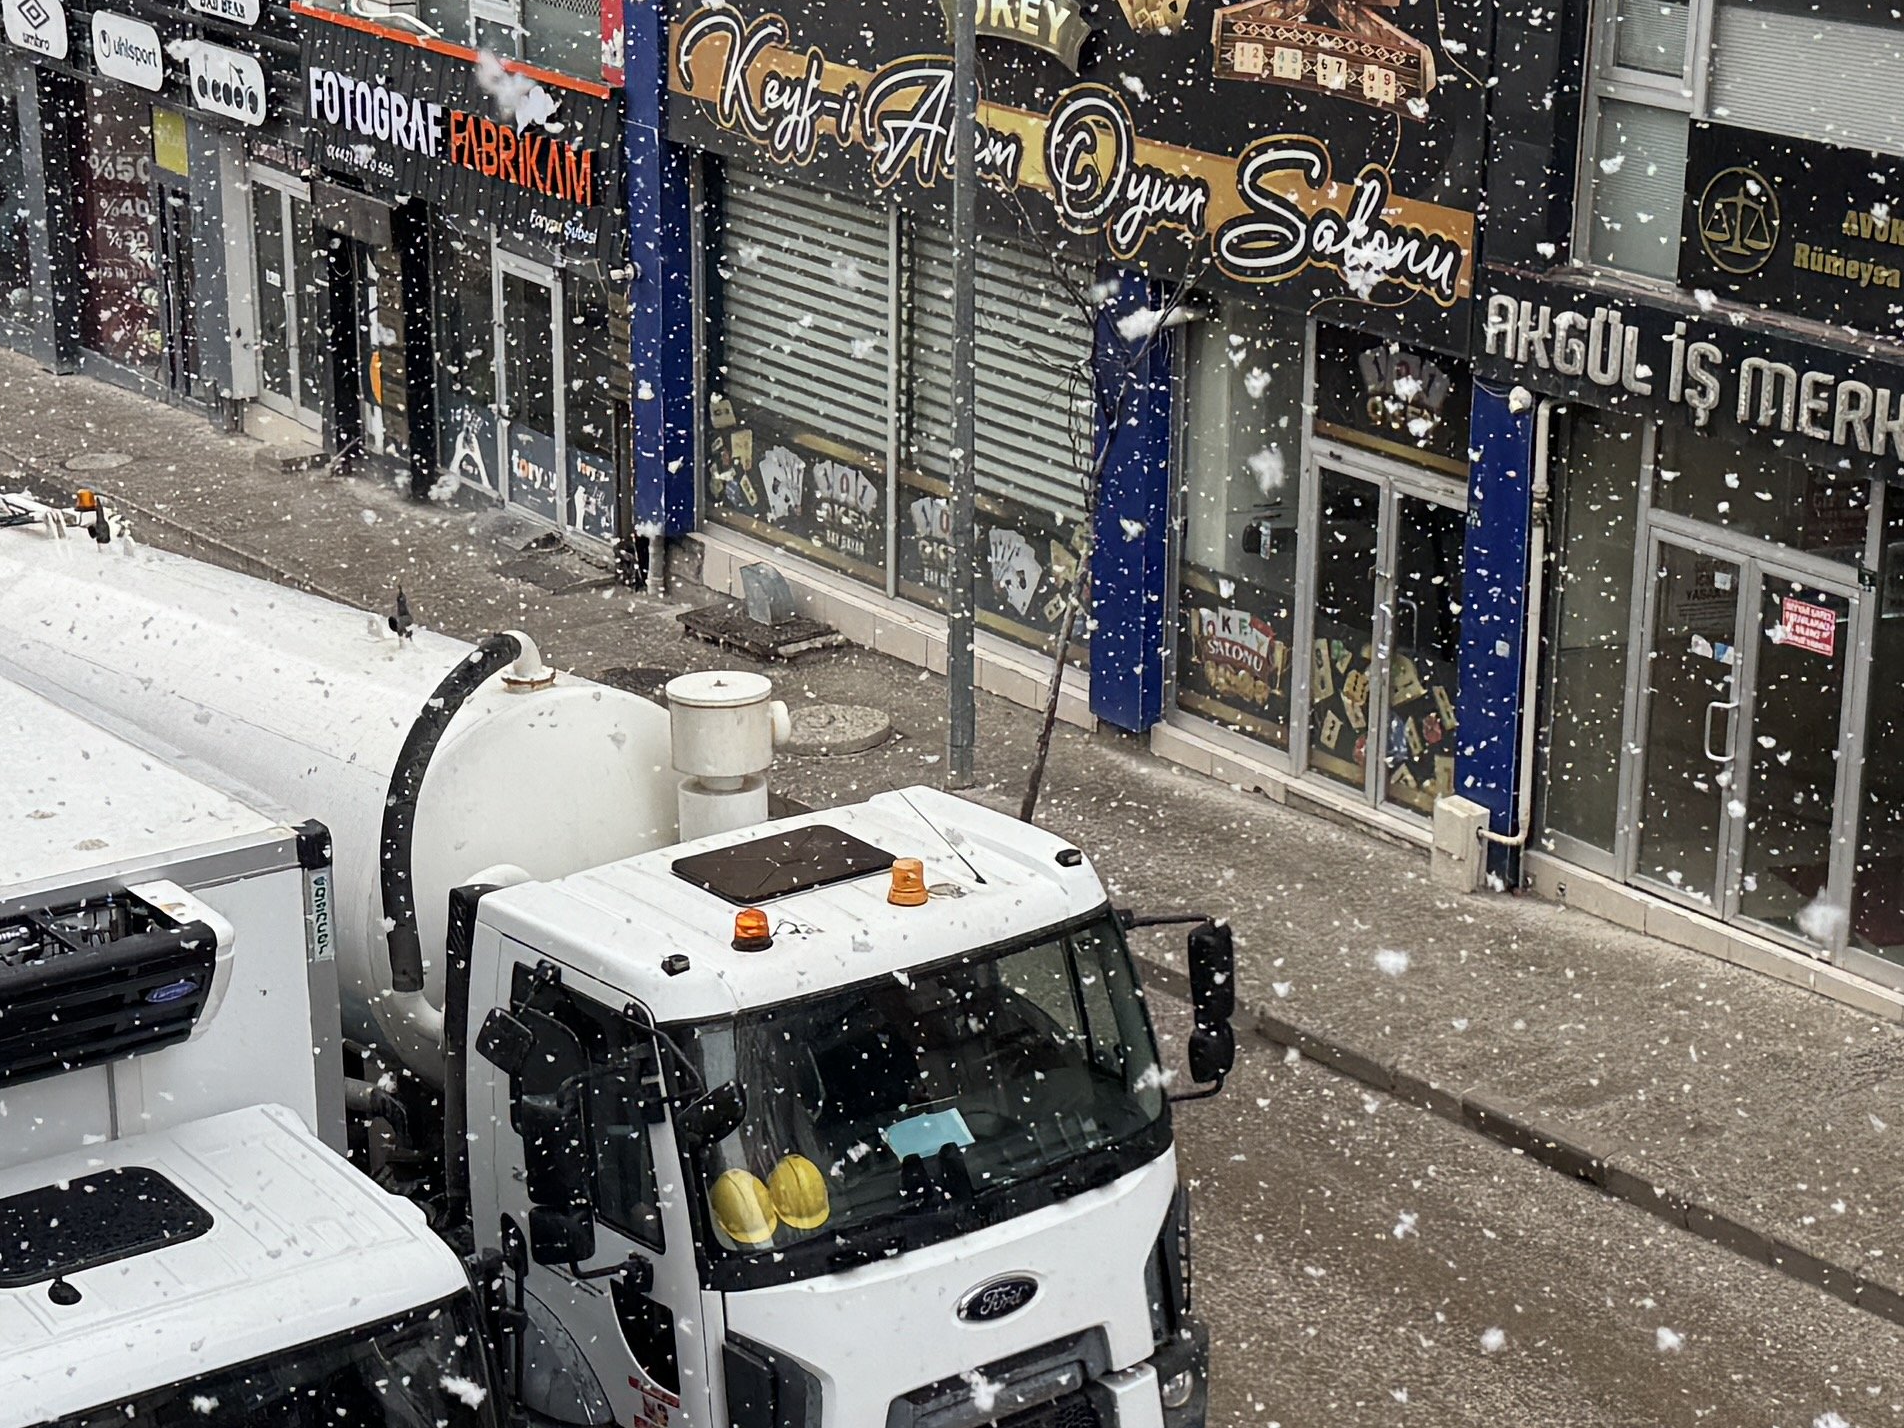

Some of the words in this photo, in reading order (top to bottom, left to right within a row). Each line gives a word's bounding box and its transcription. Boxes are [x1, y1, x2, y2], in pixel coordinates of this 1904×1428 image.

[22, 31, 50, 52] umbro
[113, 34, 159, 69] uhlsport
[309, 66, 443, 159] FOTOĞRAF
[449, 108, 593, 209] FABRİKAM
[1793, 242, 1901, 288] Rümeysa
[1484, 294, 1653, 396] AKGÜL
[1663, 321, 1723, 427] İŞ
[979, 1285, 1027, 1316] Ford
